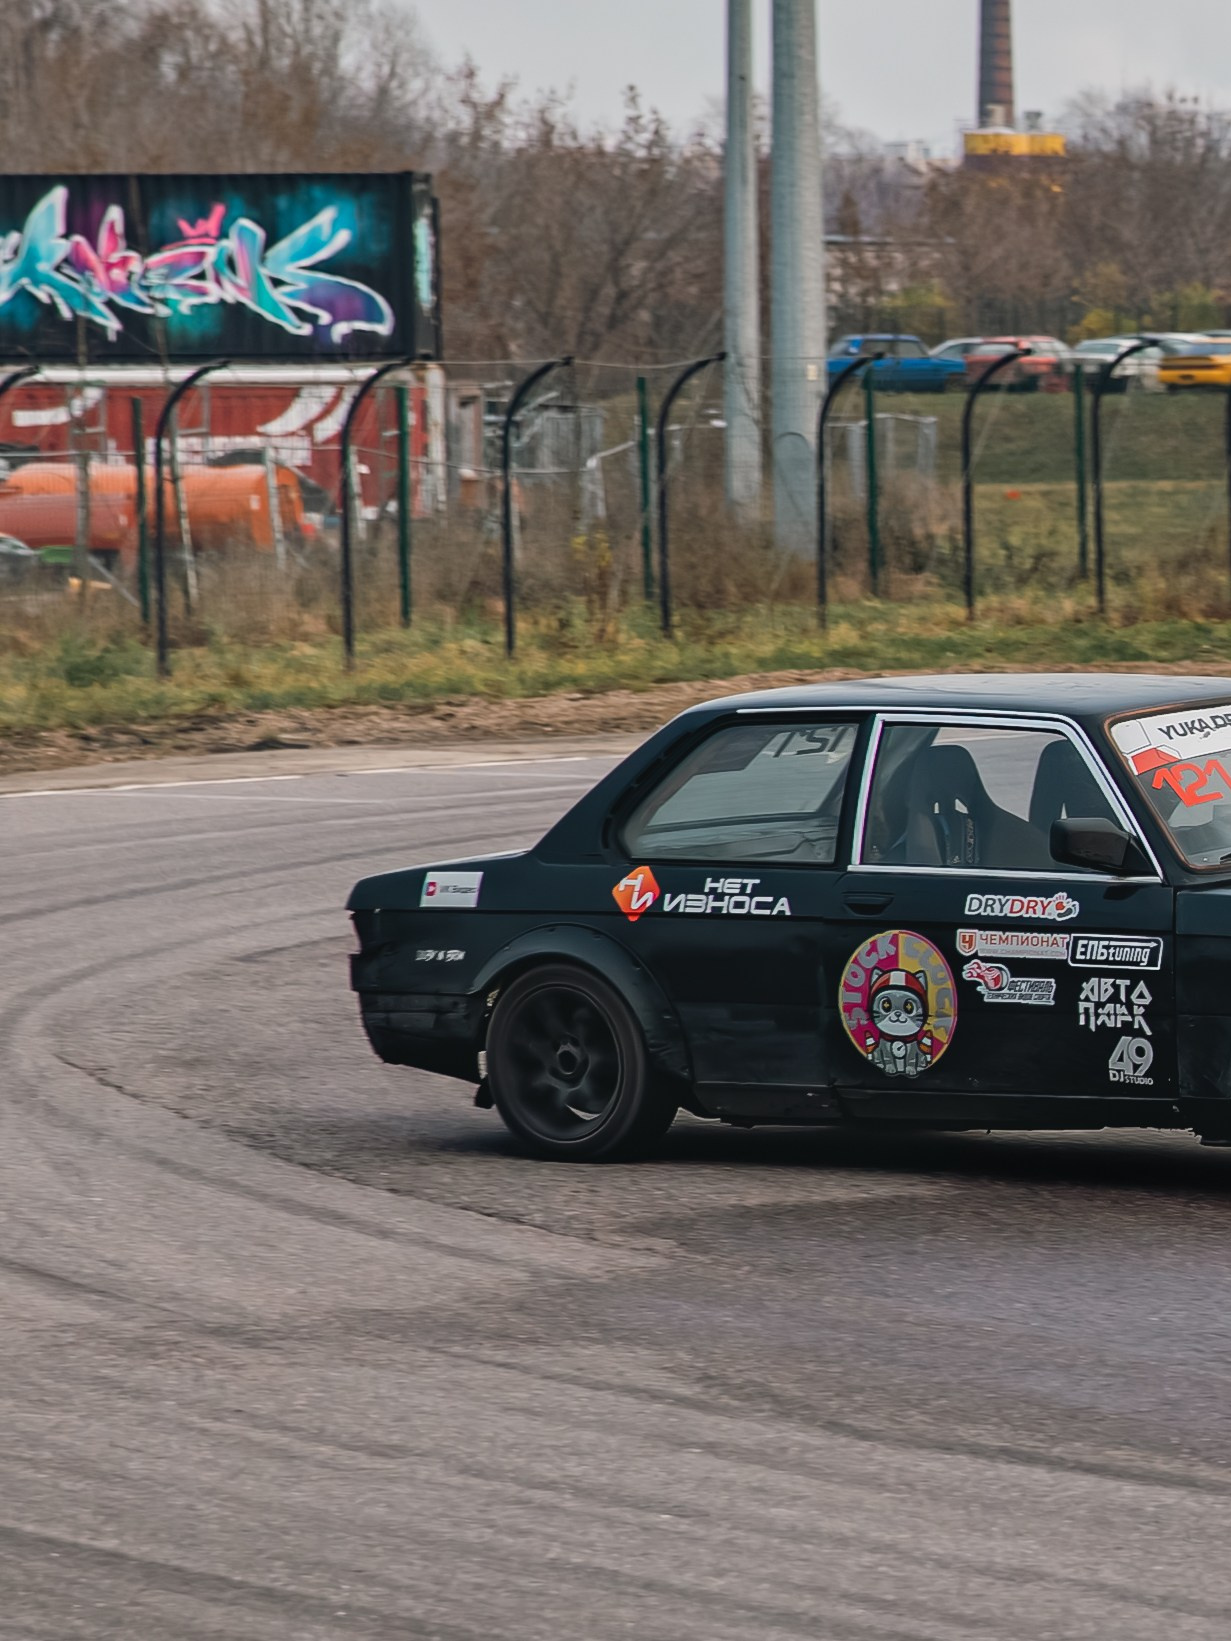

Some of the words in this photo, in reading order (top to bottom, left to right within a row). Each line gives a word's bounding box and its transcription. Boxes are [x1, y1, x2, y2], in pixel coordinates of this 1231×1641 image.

[1158, 715, 1213, 740] YUKA
[703, 877, 760, 894] НЕТ
[663, 893, 792, 916] ИЗНОСА
[967, 896, 1052, 916] DRYDRY
[980, 933, 1068, 949] ЧЕМПИОНАТ
[841, 934, 897, 1031] STOCK
[1079, 977, 1153, 1005] АВТО
[1078, 1001, 1153, 1036] ПАРК
[1108, 1036, 1154, 1076] 49
[1125, 1075, 1154, 1086] STUDIO
